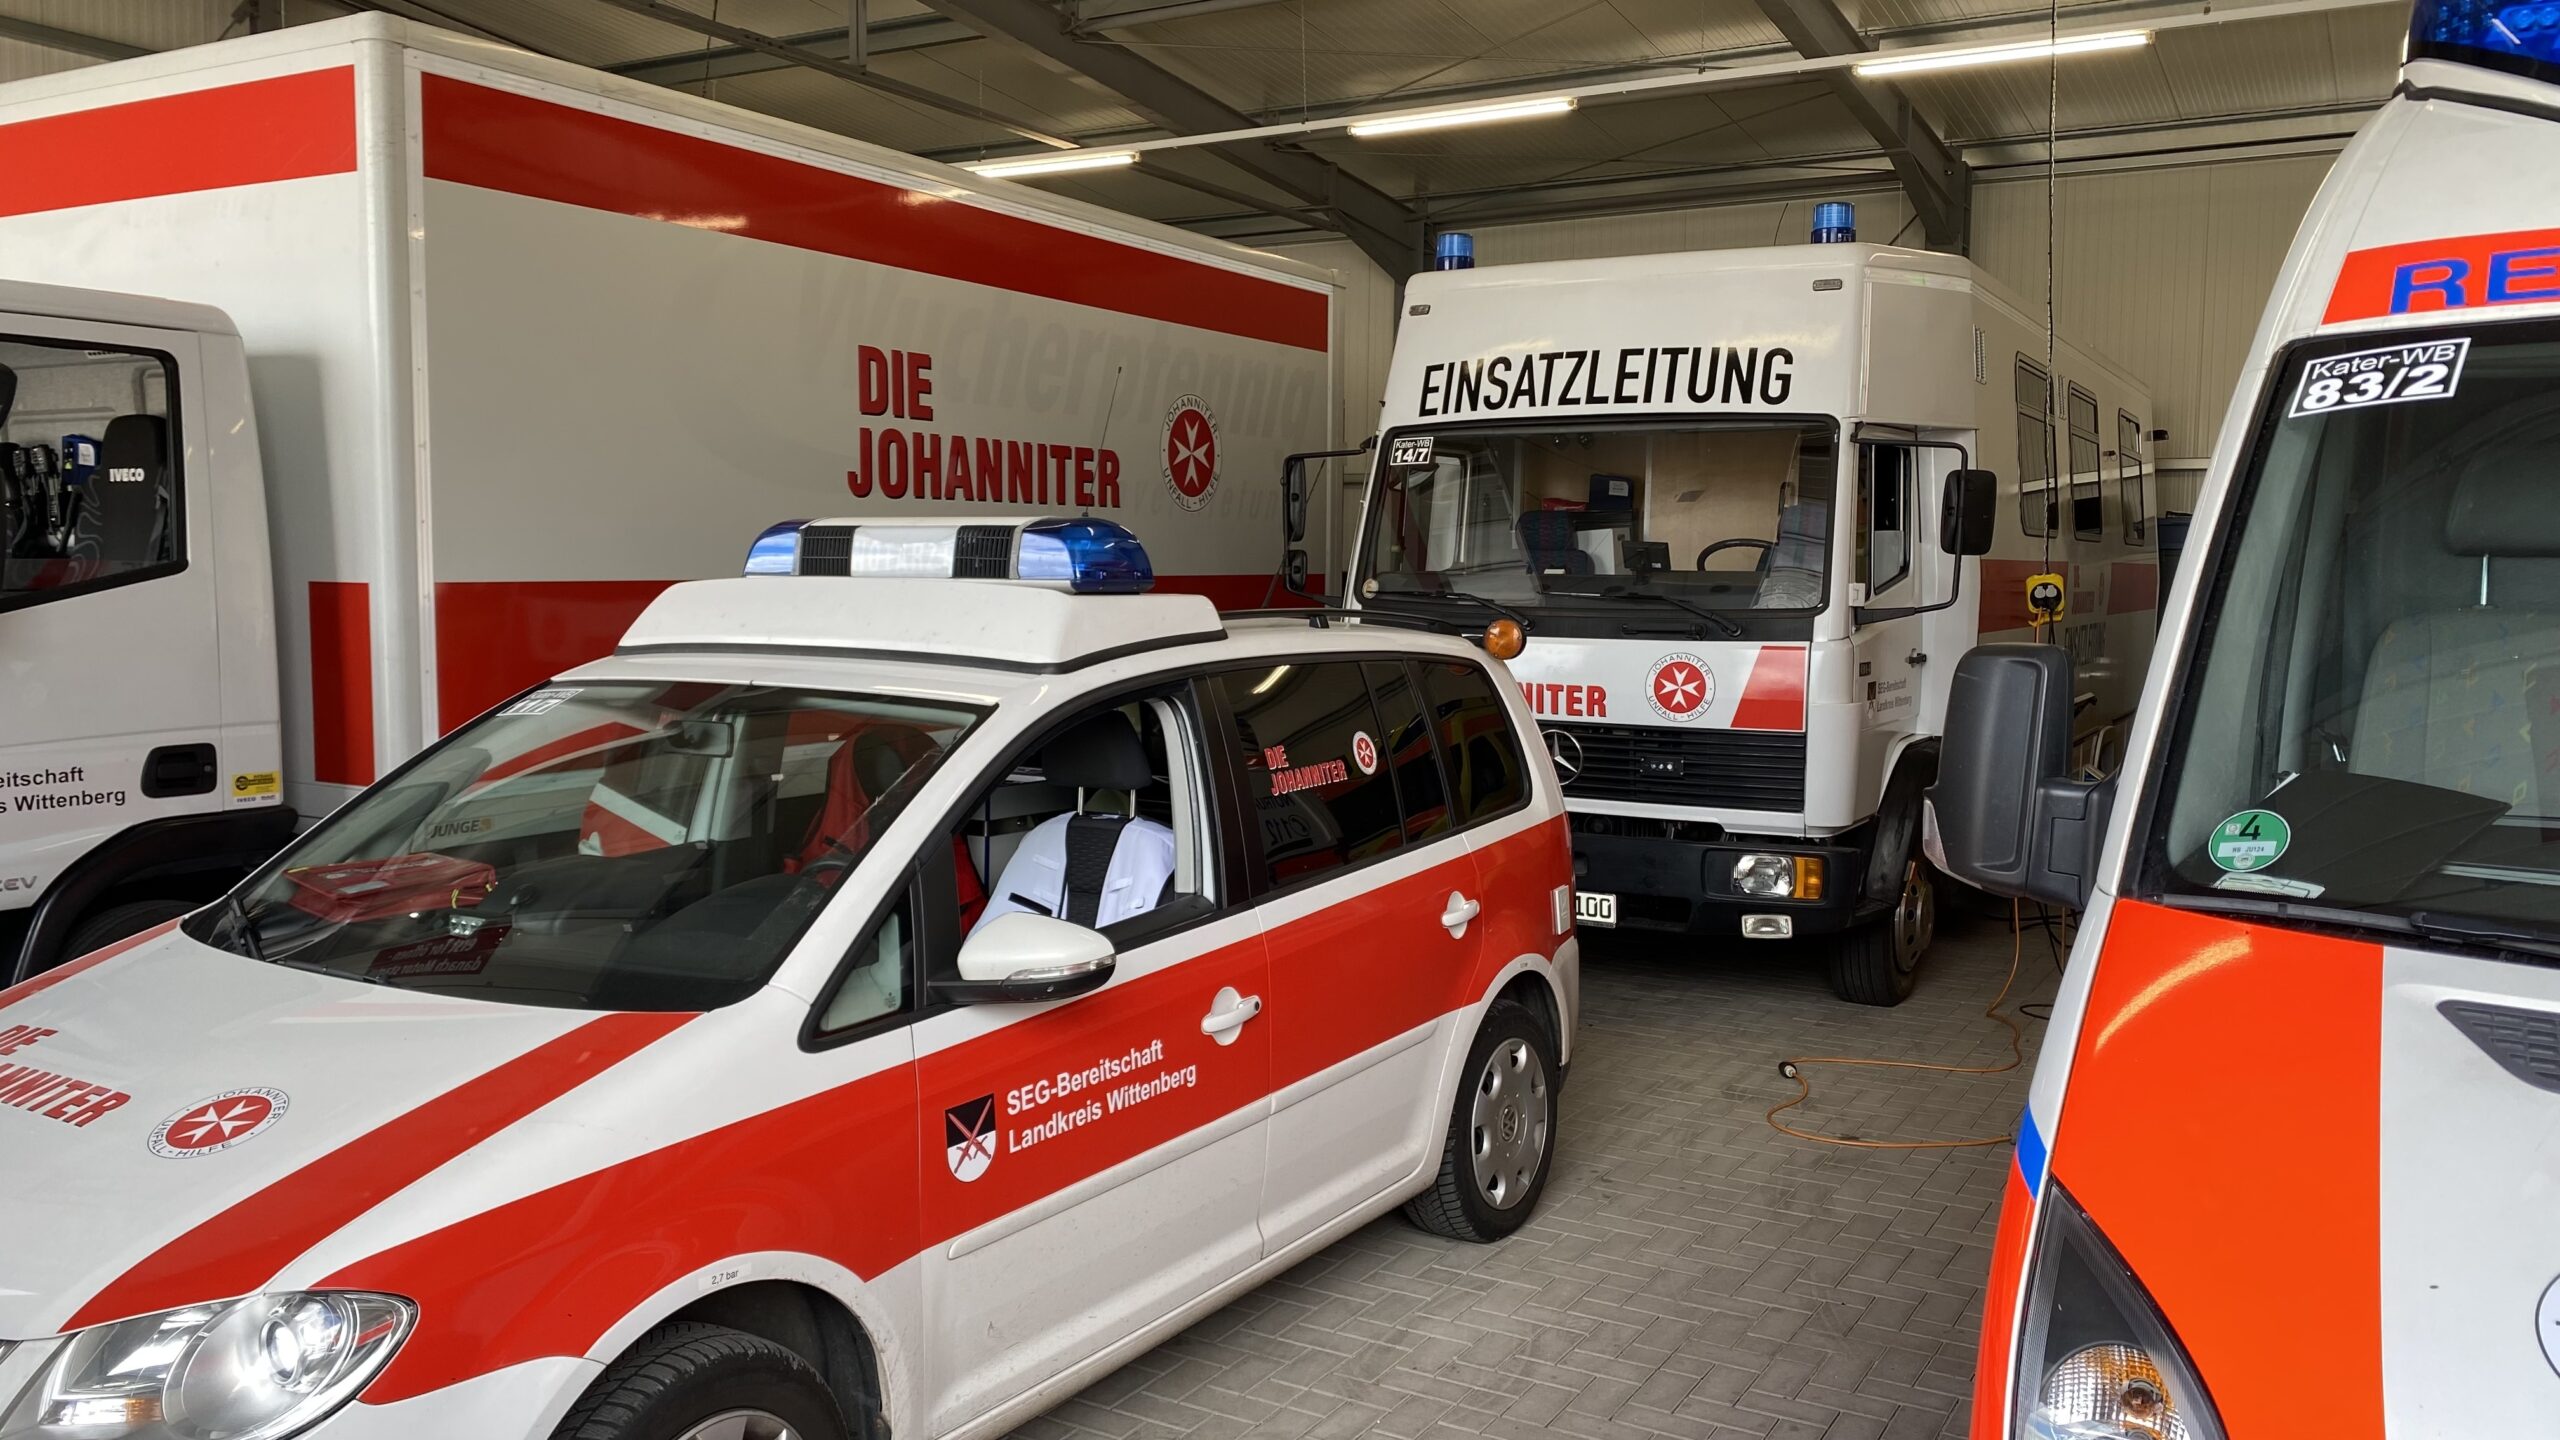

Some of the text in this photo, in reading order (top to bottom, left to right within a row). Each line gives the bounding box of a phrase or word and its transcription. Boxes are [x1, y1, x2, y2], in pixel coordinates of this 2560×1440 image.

[2311, 344, 2456, 380] Kater-WB
[858, 344, 933, 421] DIE
[1418, 346, 1794, 417] EINSATZLEITUNG
[2302, 363, 2449, 410] 83/2
[1394, 447, 1429, 463] 14/7
[1395, 439, 1431, 449] Kater-WB
[109, 467, 145, 482] IVECO
[847, 427, 1121, 508] JOHANNITER
[1264, 745, 1289, 770] DIE
[1271, 759, 1348, 796] JOHANNITER
[14, 790, 126, 813] Wittenberg
[430, 820, 480, 839] JUNGE
[2239, 814, 2262, 841] 4
[1576, 896, 1611, 919] 100
[1007, 1039, 1163, 1116] SEG-Bereitschaft
[0, 1063, 131, 1128] NNITER
[1009, 1064, 1197, 1153] Landkreis Wittenberg
[711, 1270, 739, 1285] 2,7 bar
